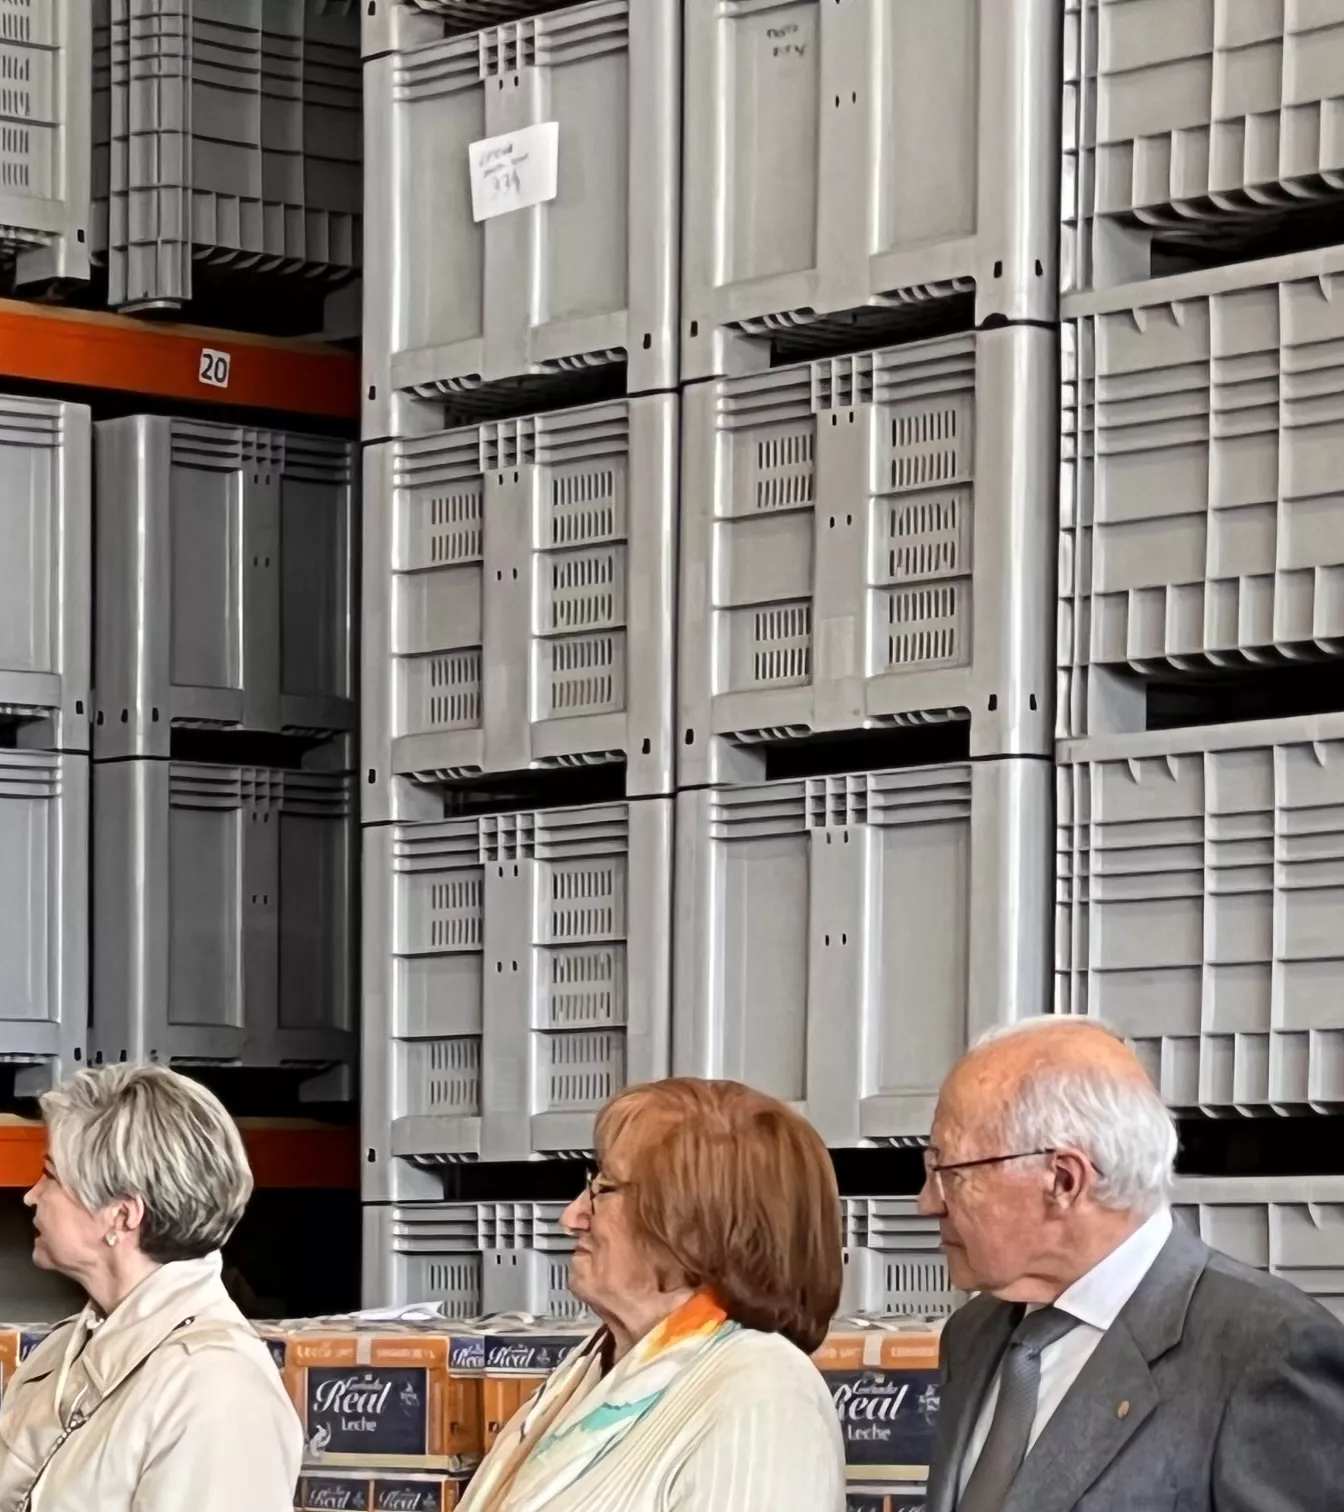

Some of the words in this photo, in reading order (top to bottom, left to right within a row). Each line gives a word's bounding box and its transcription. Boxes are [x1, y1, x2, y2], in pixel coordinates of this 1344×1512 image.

[202, 356, 228, 383] 20
[314, 1377, 392, 1414] Real
[342, 1416, 377, 1432] Leche
[848, 1423, 891, 1441] Leche
